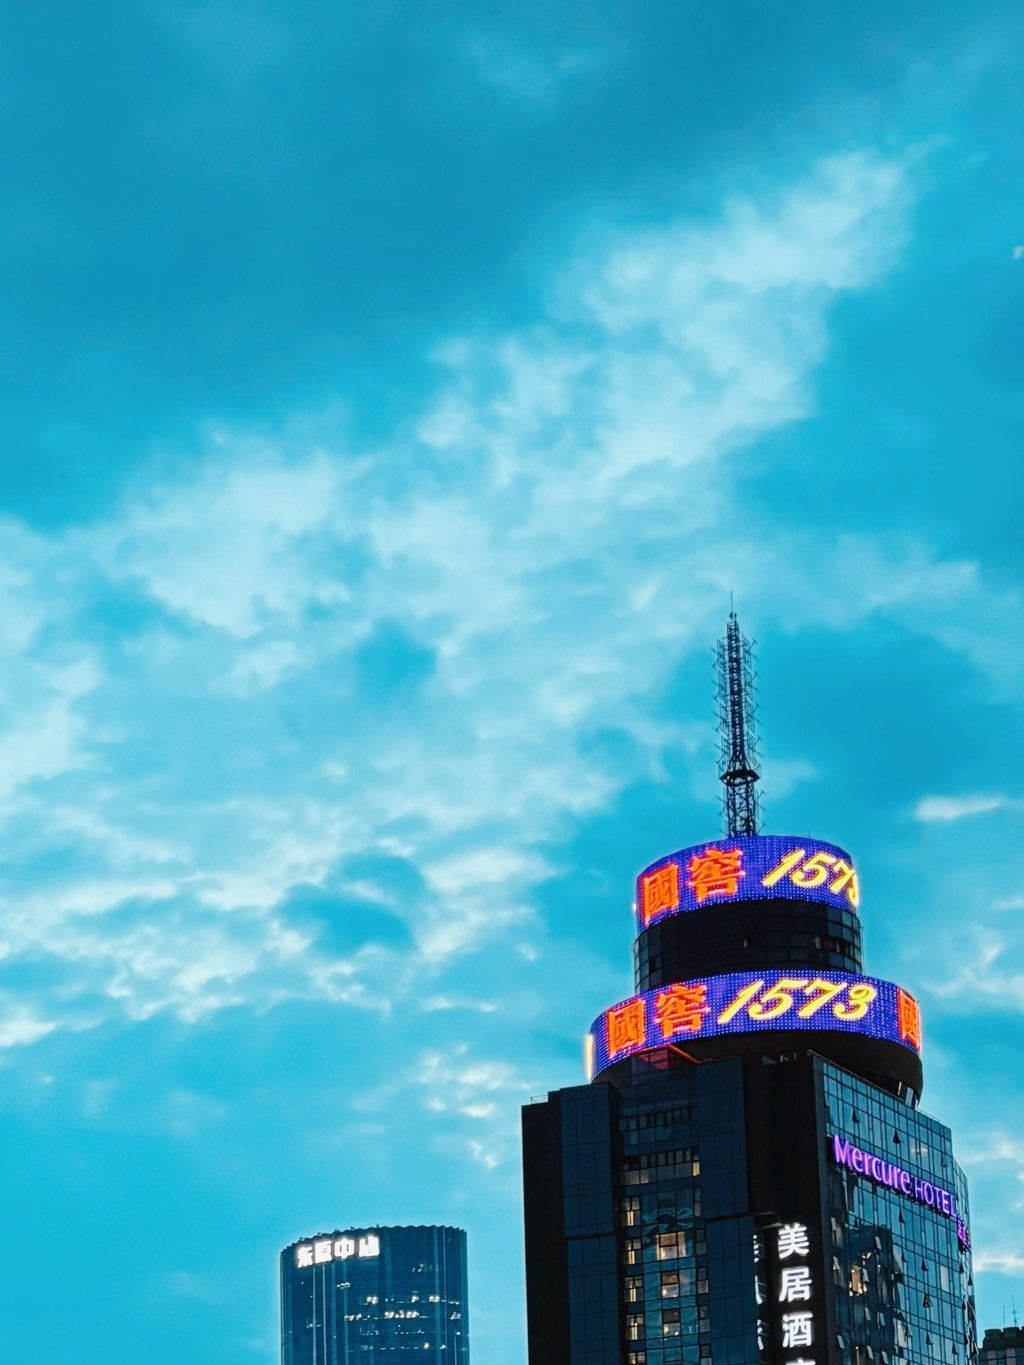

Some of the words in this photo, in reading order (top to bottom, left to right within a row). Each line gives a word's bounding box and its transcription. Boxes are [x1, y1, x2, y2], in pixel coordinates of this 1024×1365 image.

[717, 978, 877, 1025] 1573
[833, 1135, 910, 1194] Mercure
[915, 1177, 957, 1217] HOTEL
